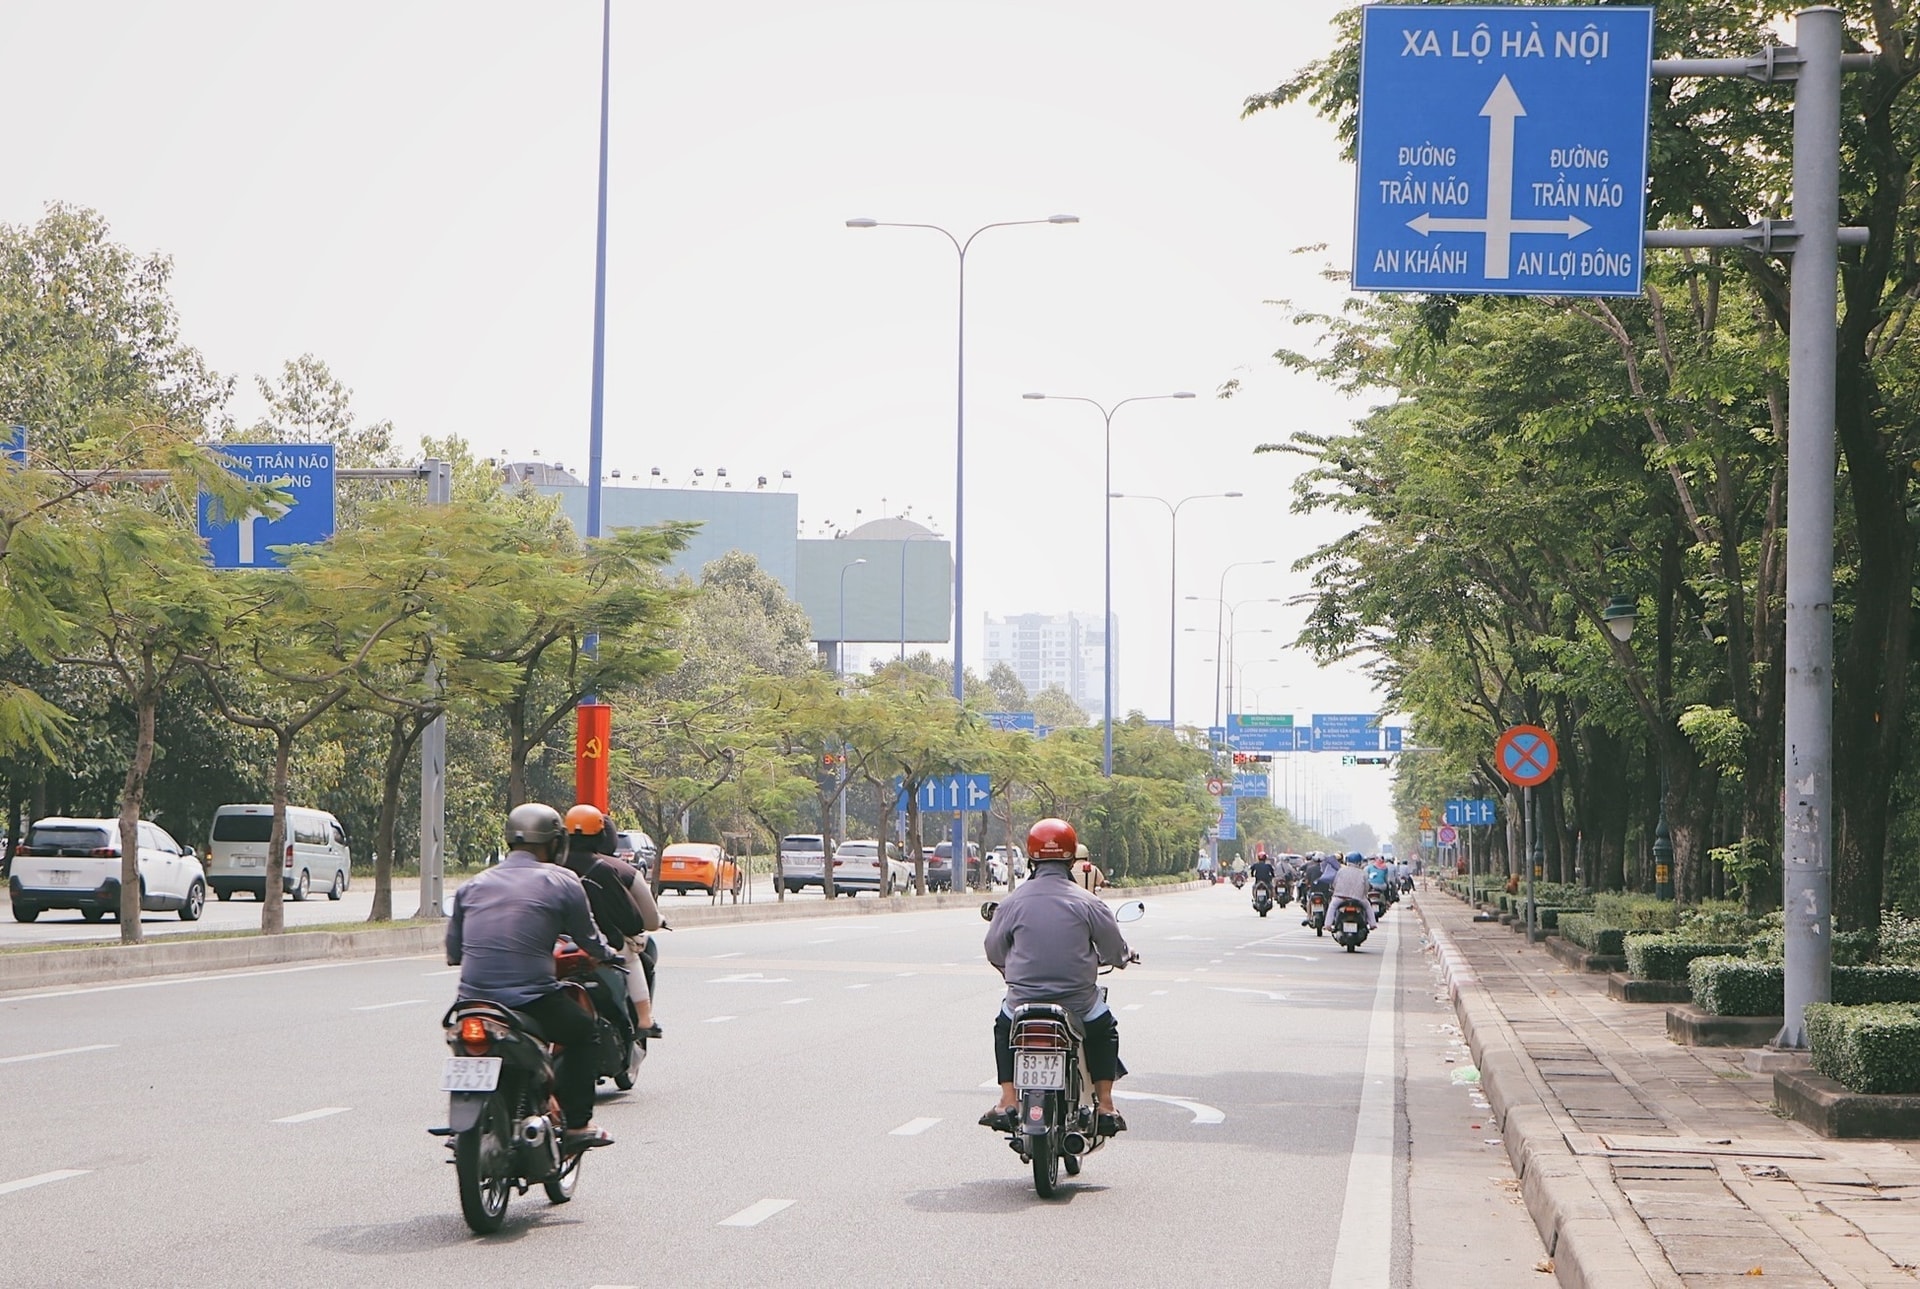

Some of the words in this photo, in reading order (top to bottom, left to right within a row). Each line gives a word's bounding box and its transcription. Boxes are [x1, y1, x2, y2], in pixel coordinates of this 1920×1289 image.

[1401, 29, 1442, 57] XA
[1451, 22, 1491, 65] LỘ
[1501, 21, 1545, 58] HÀ
[1555, 23, 1609, 65] NỘI
[1398, 140, 1457, 167] ĐƯỜNG
[1550, 143, 1609, 169] ĐƯỜNG
[1379, 171, 1427, 205] TRẦN
[1431, 175, 1469, 205] NÃO
[1531, 172, 1580, 207] TRẦN
[1584, 177, 1623, 207] NÃO
[1373, 250, 1399, 273] AN
[1404, 243, 1468, 274] KHÁNH
[1516, 252, 1544, 276] AN
[1548, 250, 1577, 281] LỢI
[1580, 247, 1633, 277] ĐÔNG
[255, 451, 294, 469] TRẦN
[298, 453, 329, 469] NÃO
[1343, 756, 1355, 766] 30
[1022, 1071, 1057, 1086] 8857
